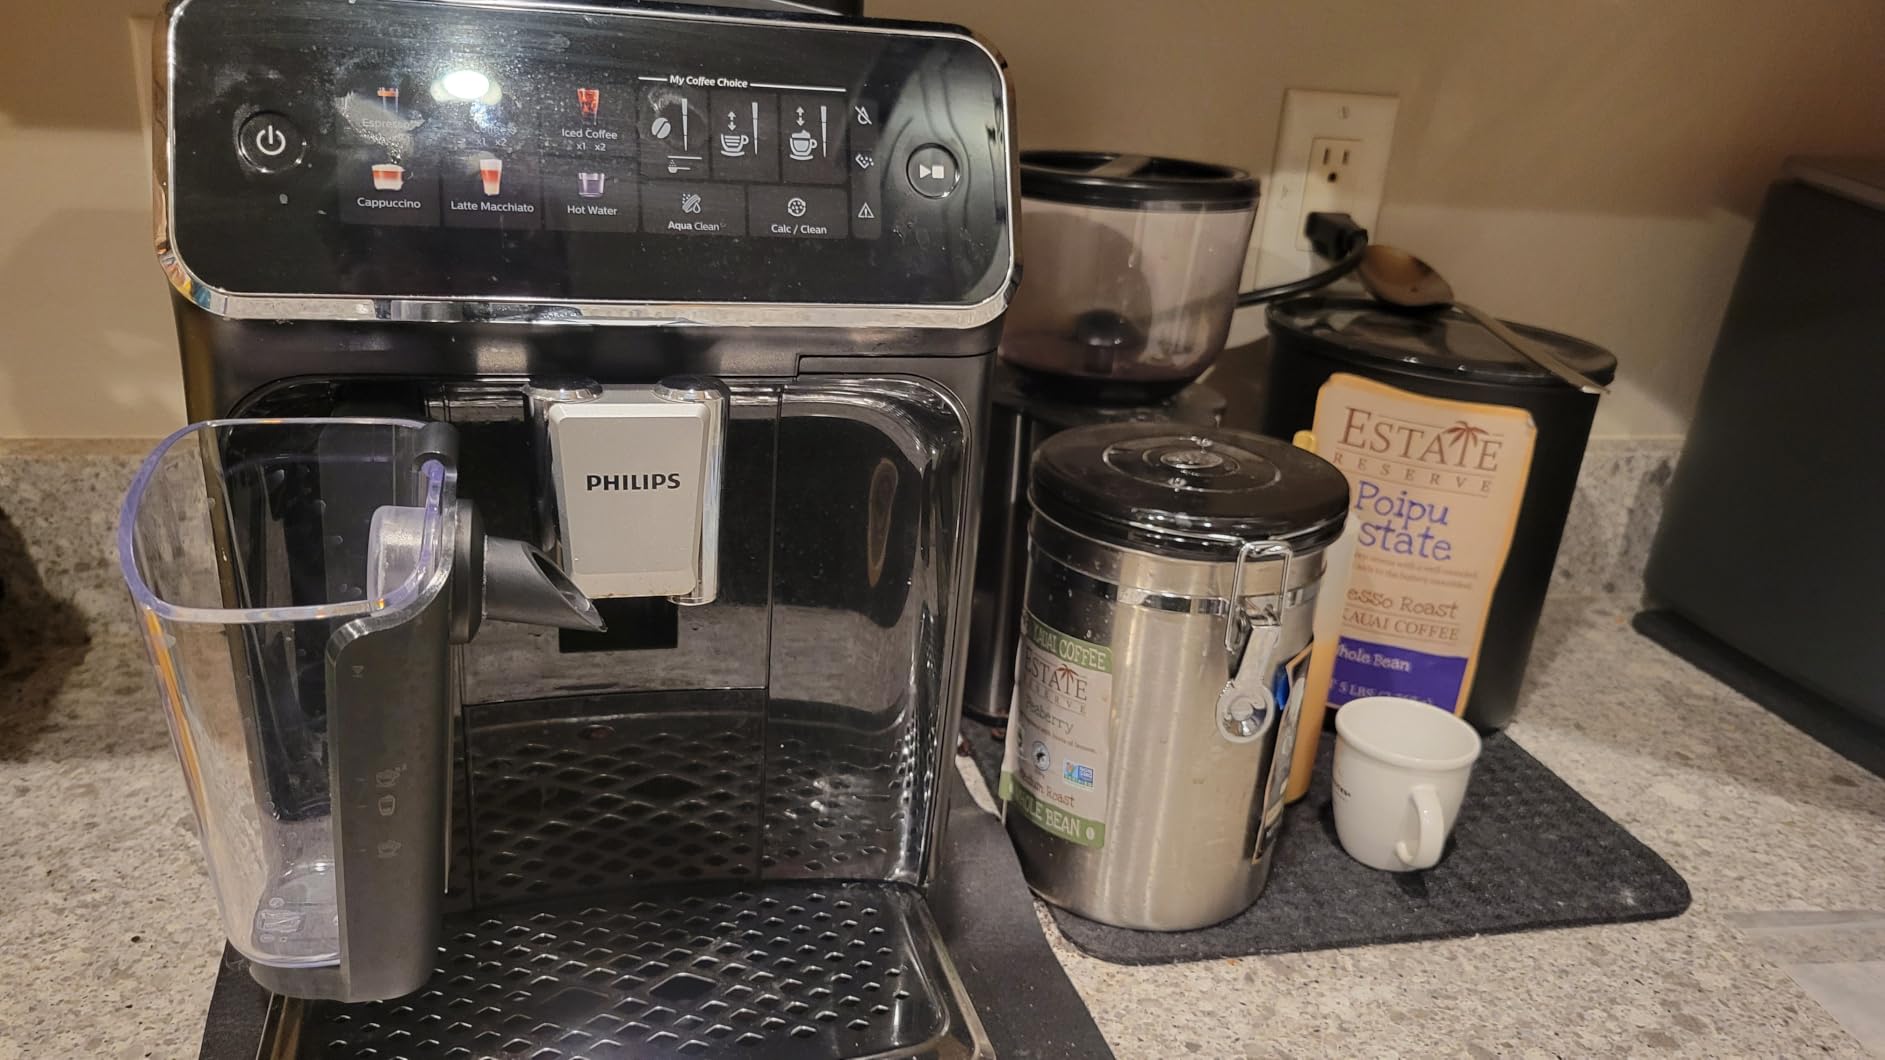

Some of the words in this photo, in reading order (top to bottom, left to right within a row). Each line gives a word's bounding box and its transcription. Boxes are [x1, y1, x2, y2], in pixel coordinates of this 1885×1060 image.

[669, 75, 685, 87] My
[686, 76, 715, 87] Coffee
[716, 78, 748, 88] Choice
[561, 128, 583, 138] Iced
[585, 129, 618, 140] Coffee
[576, 142, 586, 151] x1
[594, 142, 606, 152] x2
[357, 197, 421, 210] Cappuccino
[451, 201, 478, 211] Latte
[480, 201, 535, 213] Macchiato
[567, 205, 585, 215] Hot
[587, 206, 618, 216] Water
[667, 220, 693, 231] Aqua
[694, 221, 720, 231] Clean
[771, 224, 792, 234] Calc
[800, 224, 827, 234] Clean
[1338, 406, 1503, 472] ESTATE
[586, 473, 681, 491] PHILIPS
[1332, 452, 1497, 494] RESERVE
[1354, 480, 1449, 530] Poipu
[1358, 519, 1452, 561] state
[1346, 588, 1393, 609] esso
[1400, 596, 1459, 619] Roast
[1394, 620, 1459, 641] COFFEE
[1059, 639, 1106, 671] COFFEE
[1338, 643, 1371, 665] hole
[1373, 653, 1411, 672] Bean
[1024, 647, 1088, 701] ESTATE
[1046, 785, 1075, 808] Roast
[1045, 807, 1080, 838] BEAN
